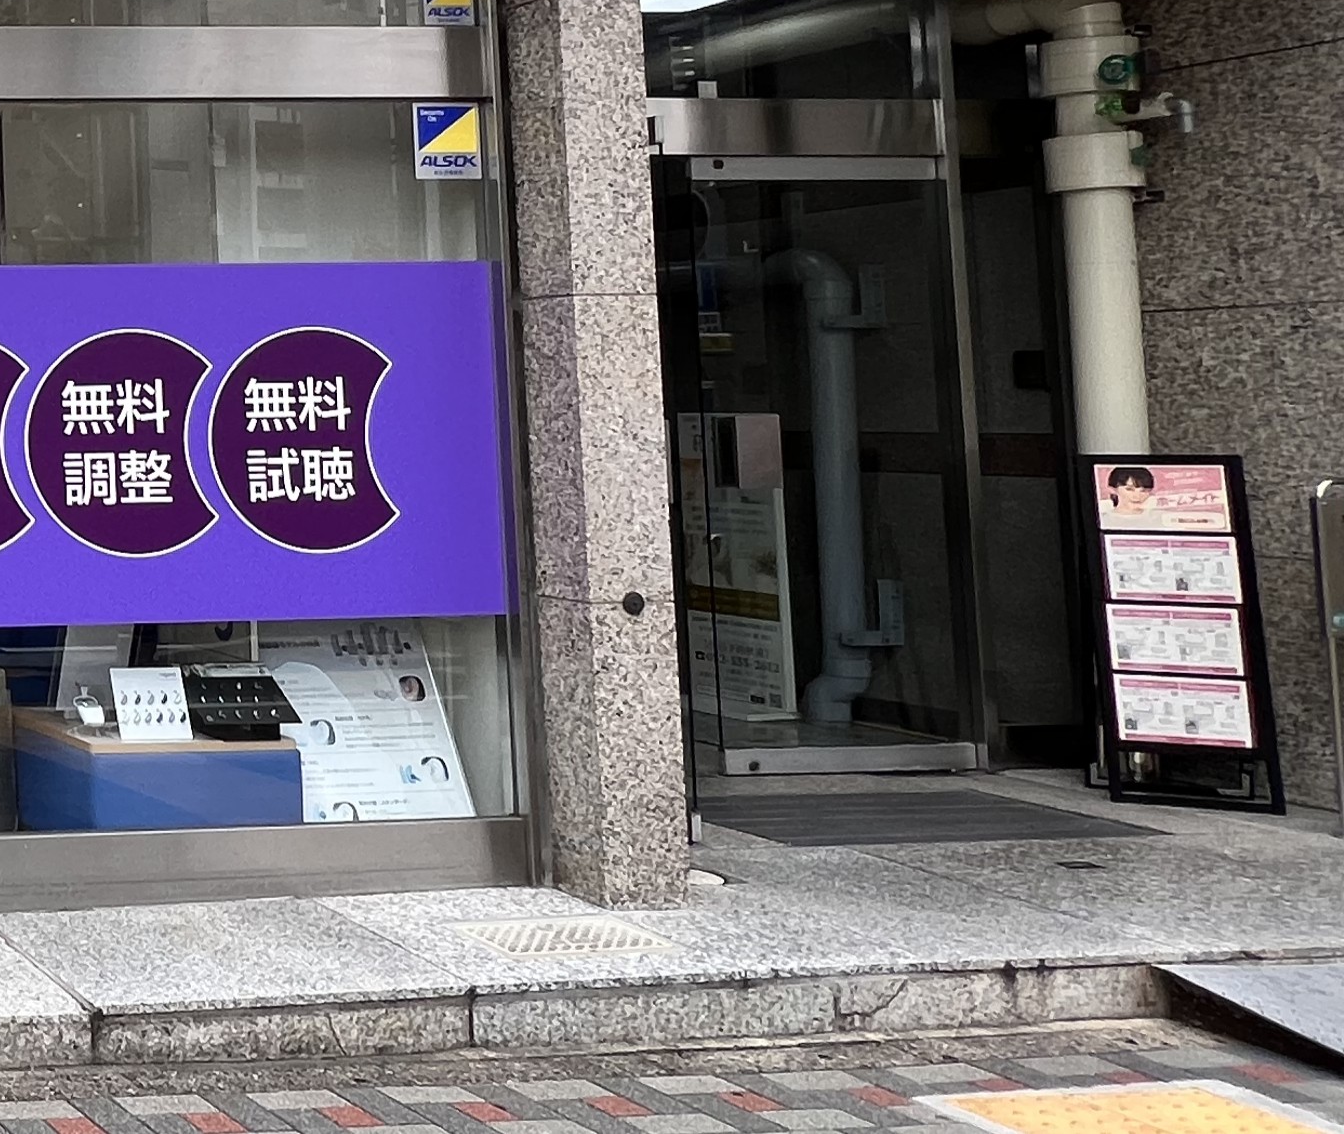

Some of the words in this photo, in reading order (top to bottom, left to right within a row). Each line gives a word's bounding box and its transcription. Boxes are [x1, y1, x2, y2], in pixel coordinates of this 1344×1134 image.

[427, 7, 470, 17] ALSOK
[420, 155, 477, 167] ALSOK
[61, 378, 170, 436] 無料
[244, 376, 352, 432] 無料
[62, 449, 173, 506] 調整
[246, 446, 356, 503] 試聴
